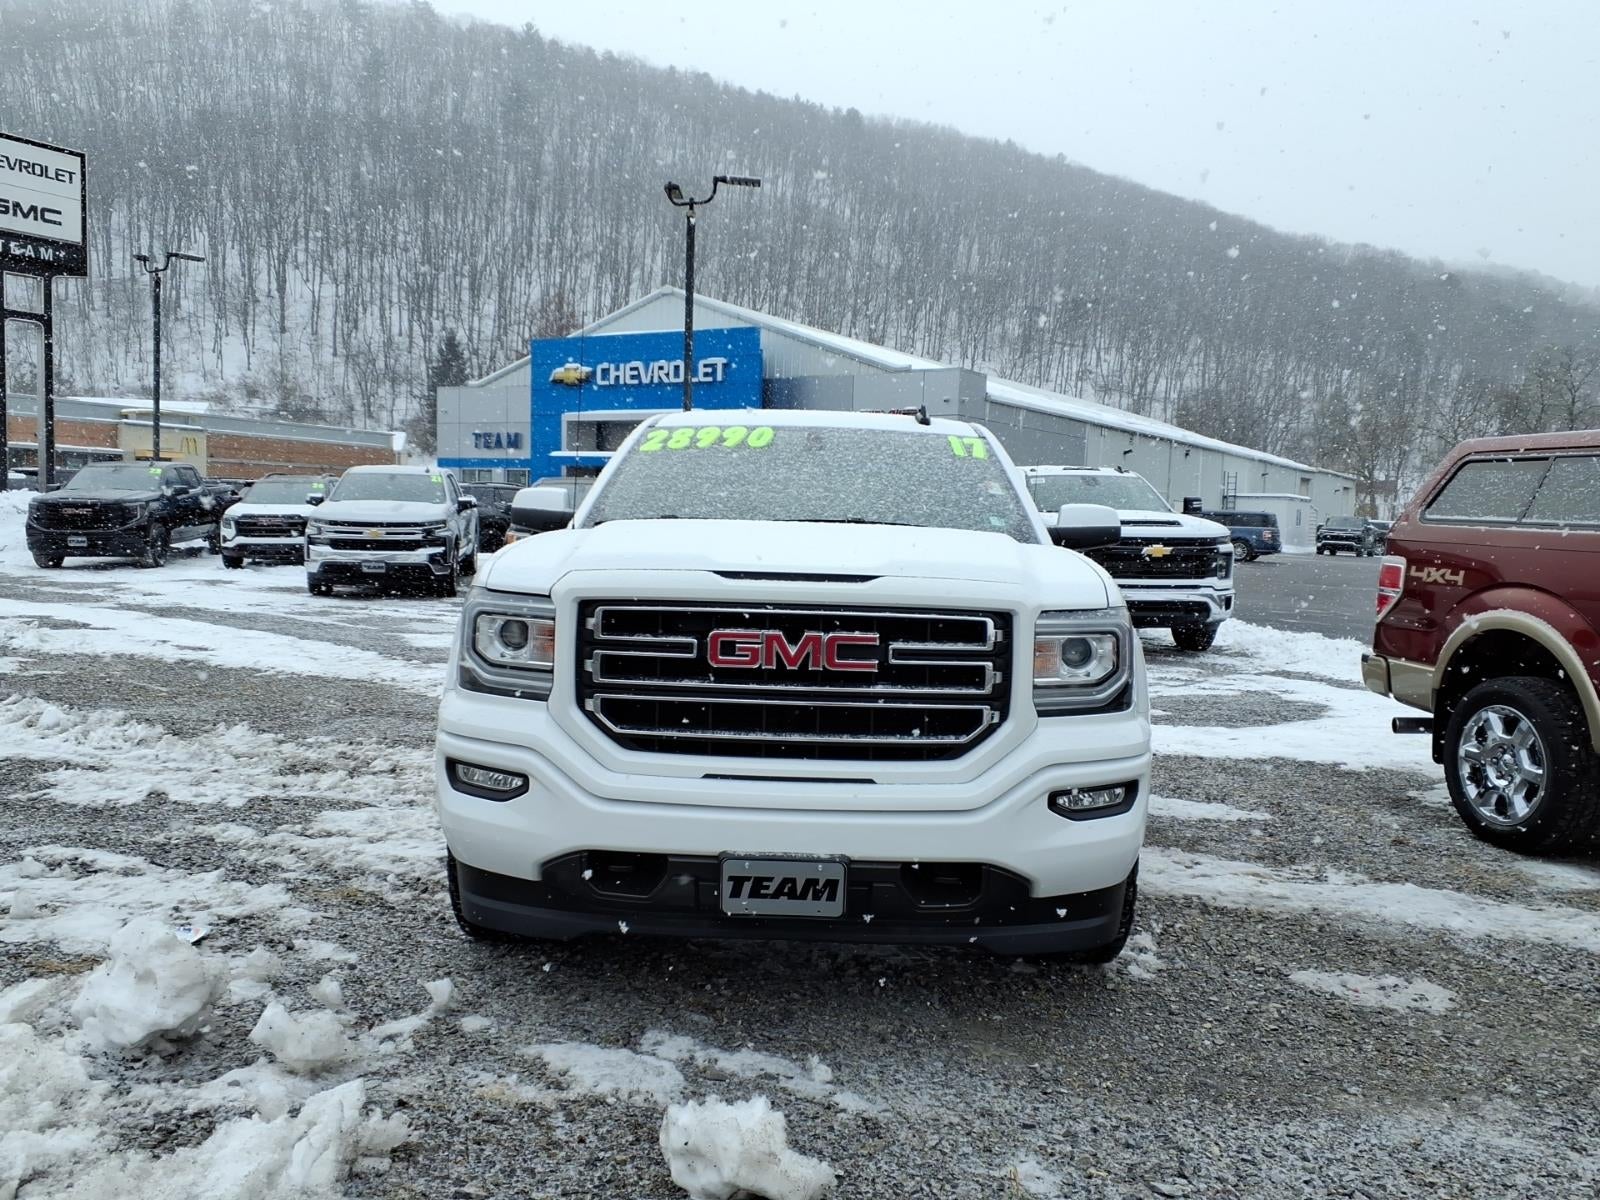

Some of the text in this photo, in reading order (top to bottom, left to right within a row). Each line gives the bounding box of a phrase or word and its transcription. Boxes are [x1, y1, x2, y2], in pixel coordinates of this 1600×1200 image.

[596, 357, 727, 386] CHEVROET
[472, 432, 522, 449] TEAM
[639, 426, 774, 452] 28990
[947, 435, 987, 460] 17
[707, 629, 880, 672] GMC
[727, 875, 840, 903] TEAM
